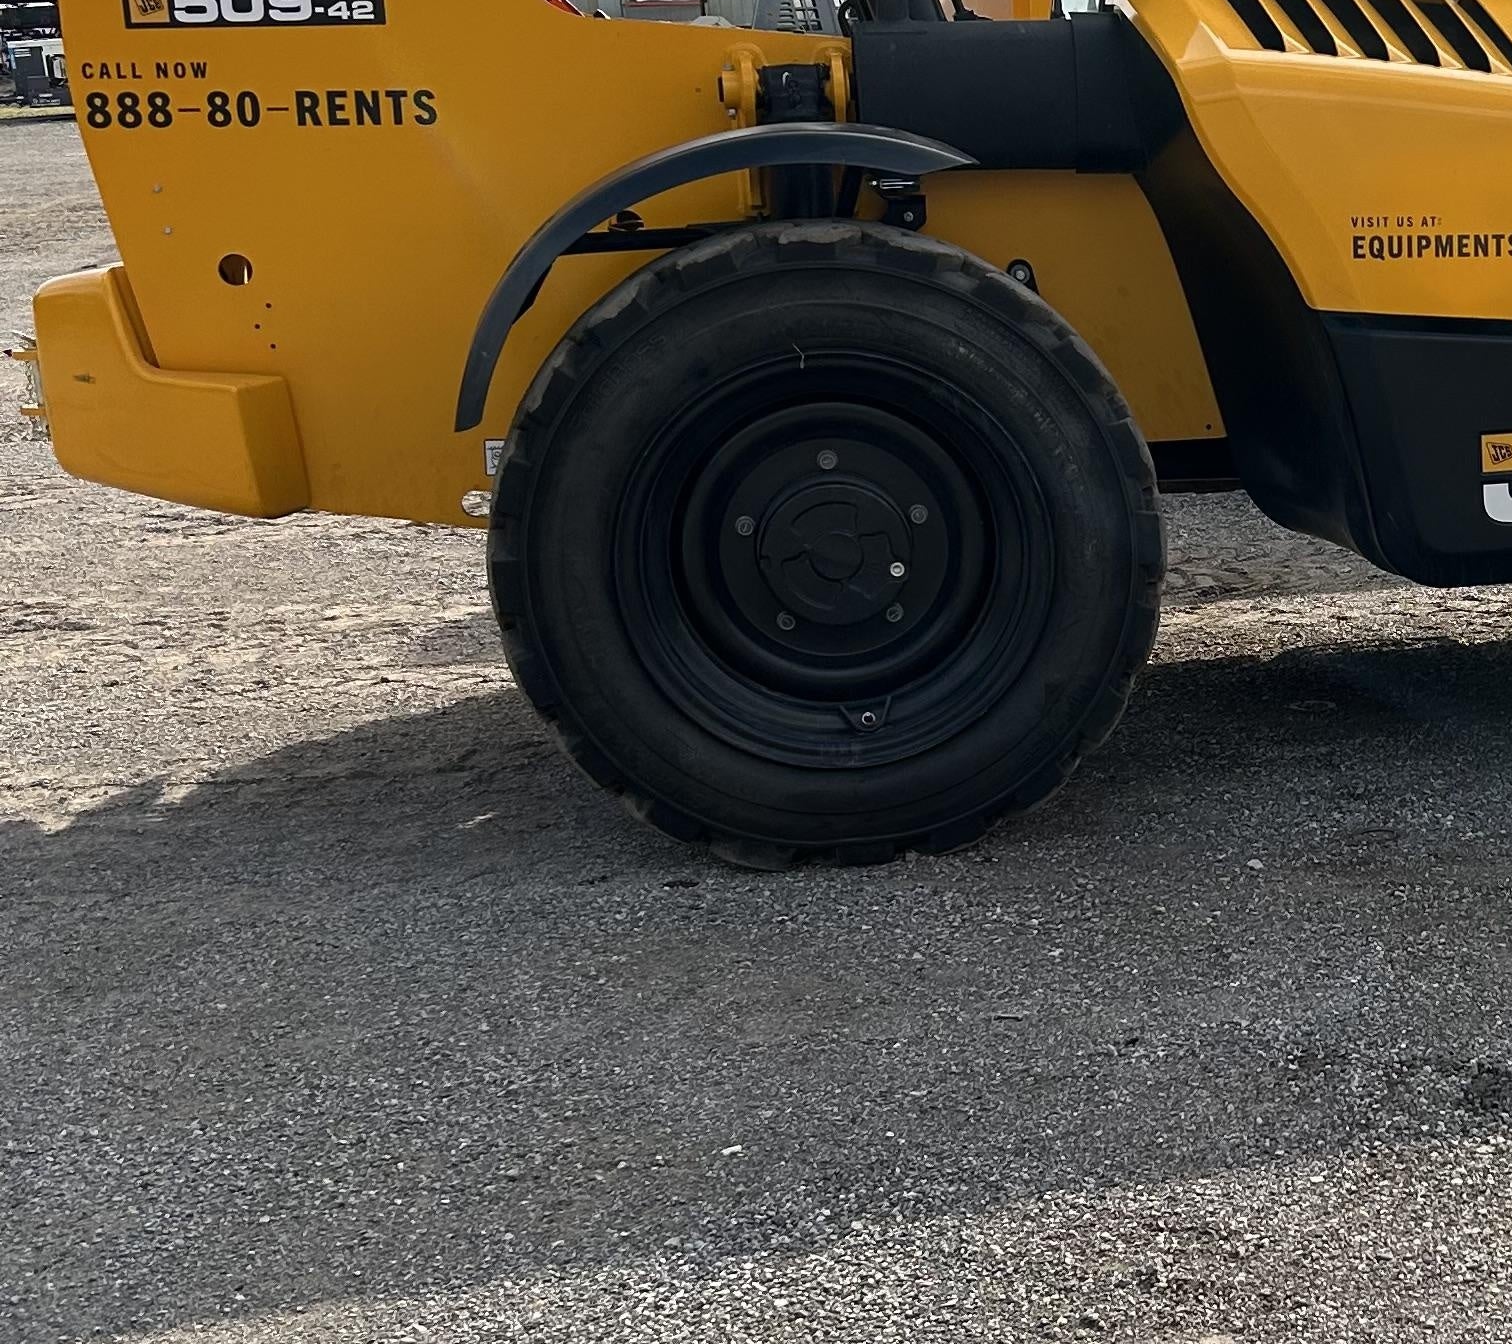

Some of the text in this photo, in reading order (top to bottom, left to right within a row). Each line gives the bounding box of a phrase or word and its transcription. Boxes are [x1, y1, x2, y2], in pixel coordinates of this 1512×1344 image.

[81, 62, 208, 79] CALL NOW
[85, 89, 438, 129] 888-80-RENTS
[1350, 216, 1389, 228] VISIT
[1396, 216, 1414, 228] US
